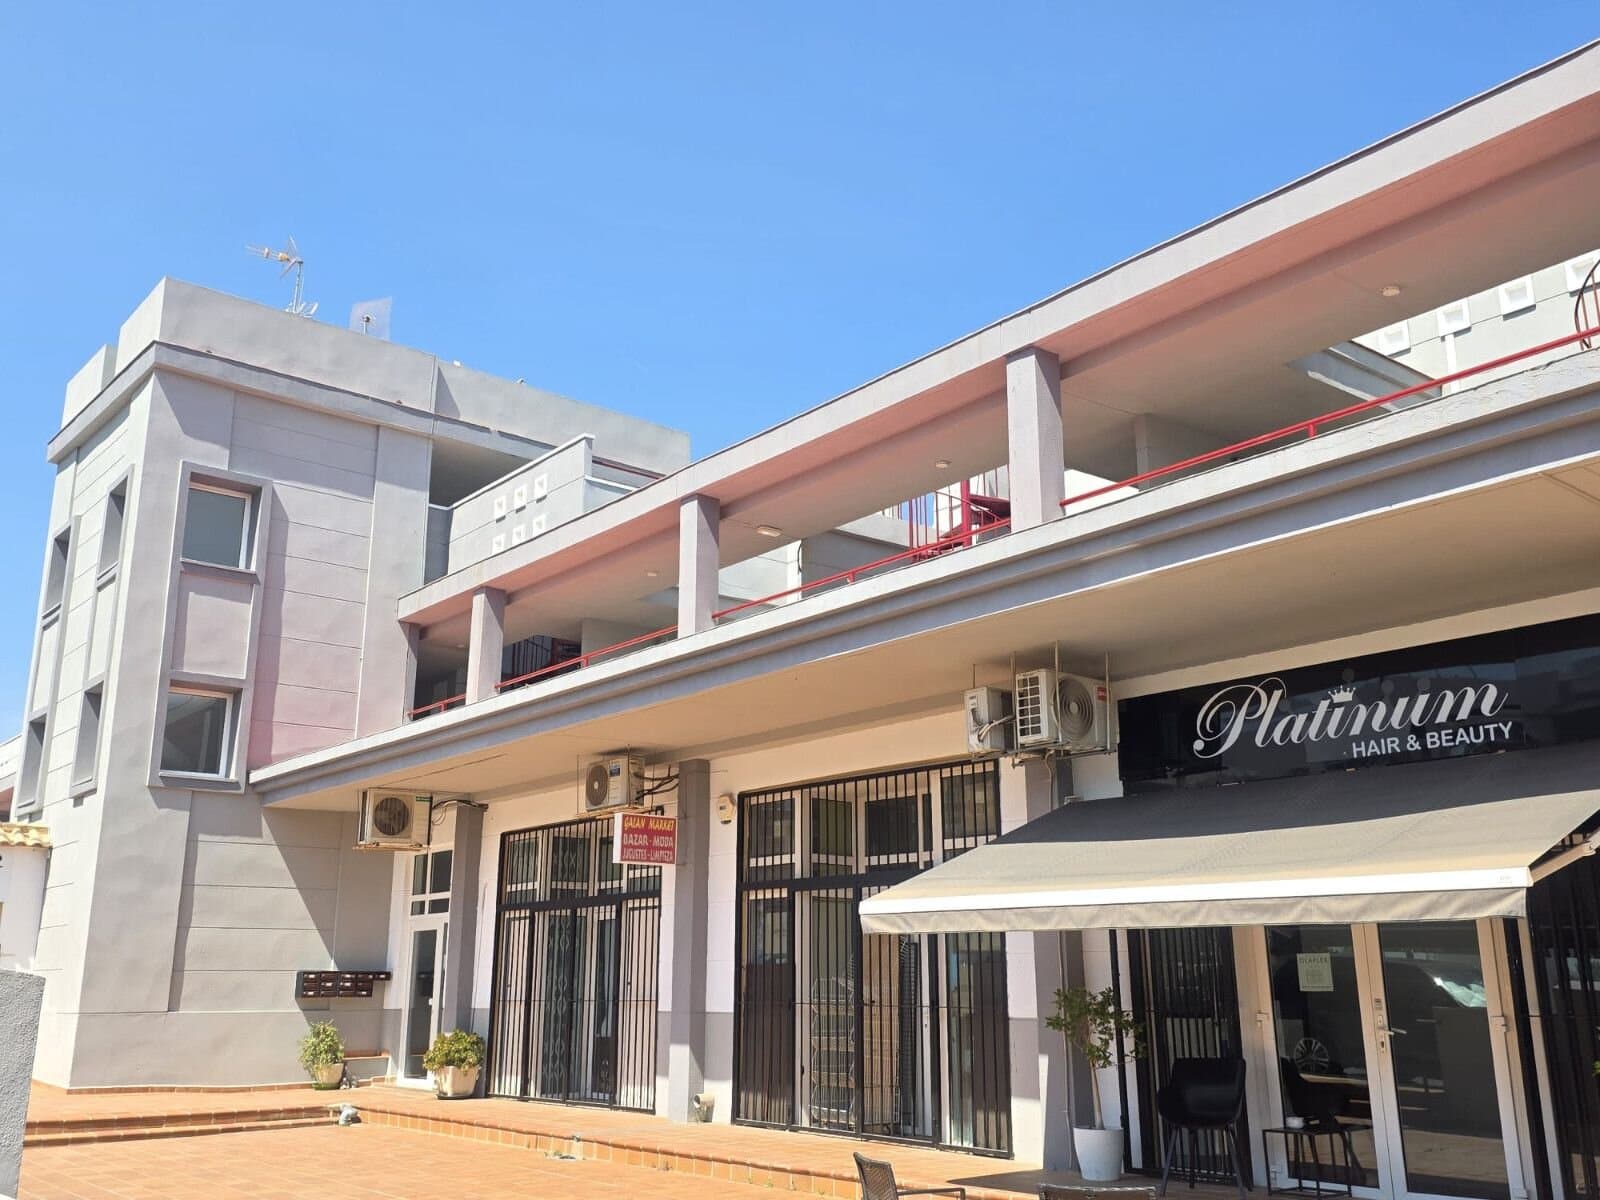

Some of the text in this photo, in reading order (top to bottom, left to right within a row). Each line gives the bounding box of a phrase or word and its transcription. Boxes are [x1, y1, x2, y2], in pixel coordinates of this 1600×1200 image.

[1193, 677, 1509, 759] Platinum
[1352, 721, 1513, 759] HAIR & BEAUTY
[623, 833, 648, 846] BAZAR
[653, 836, 674, 848] MODA
